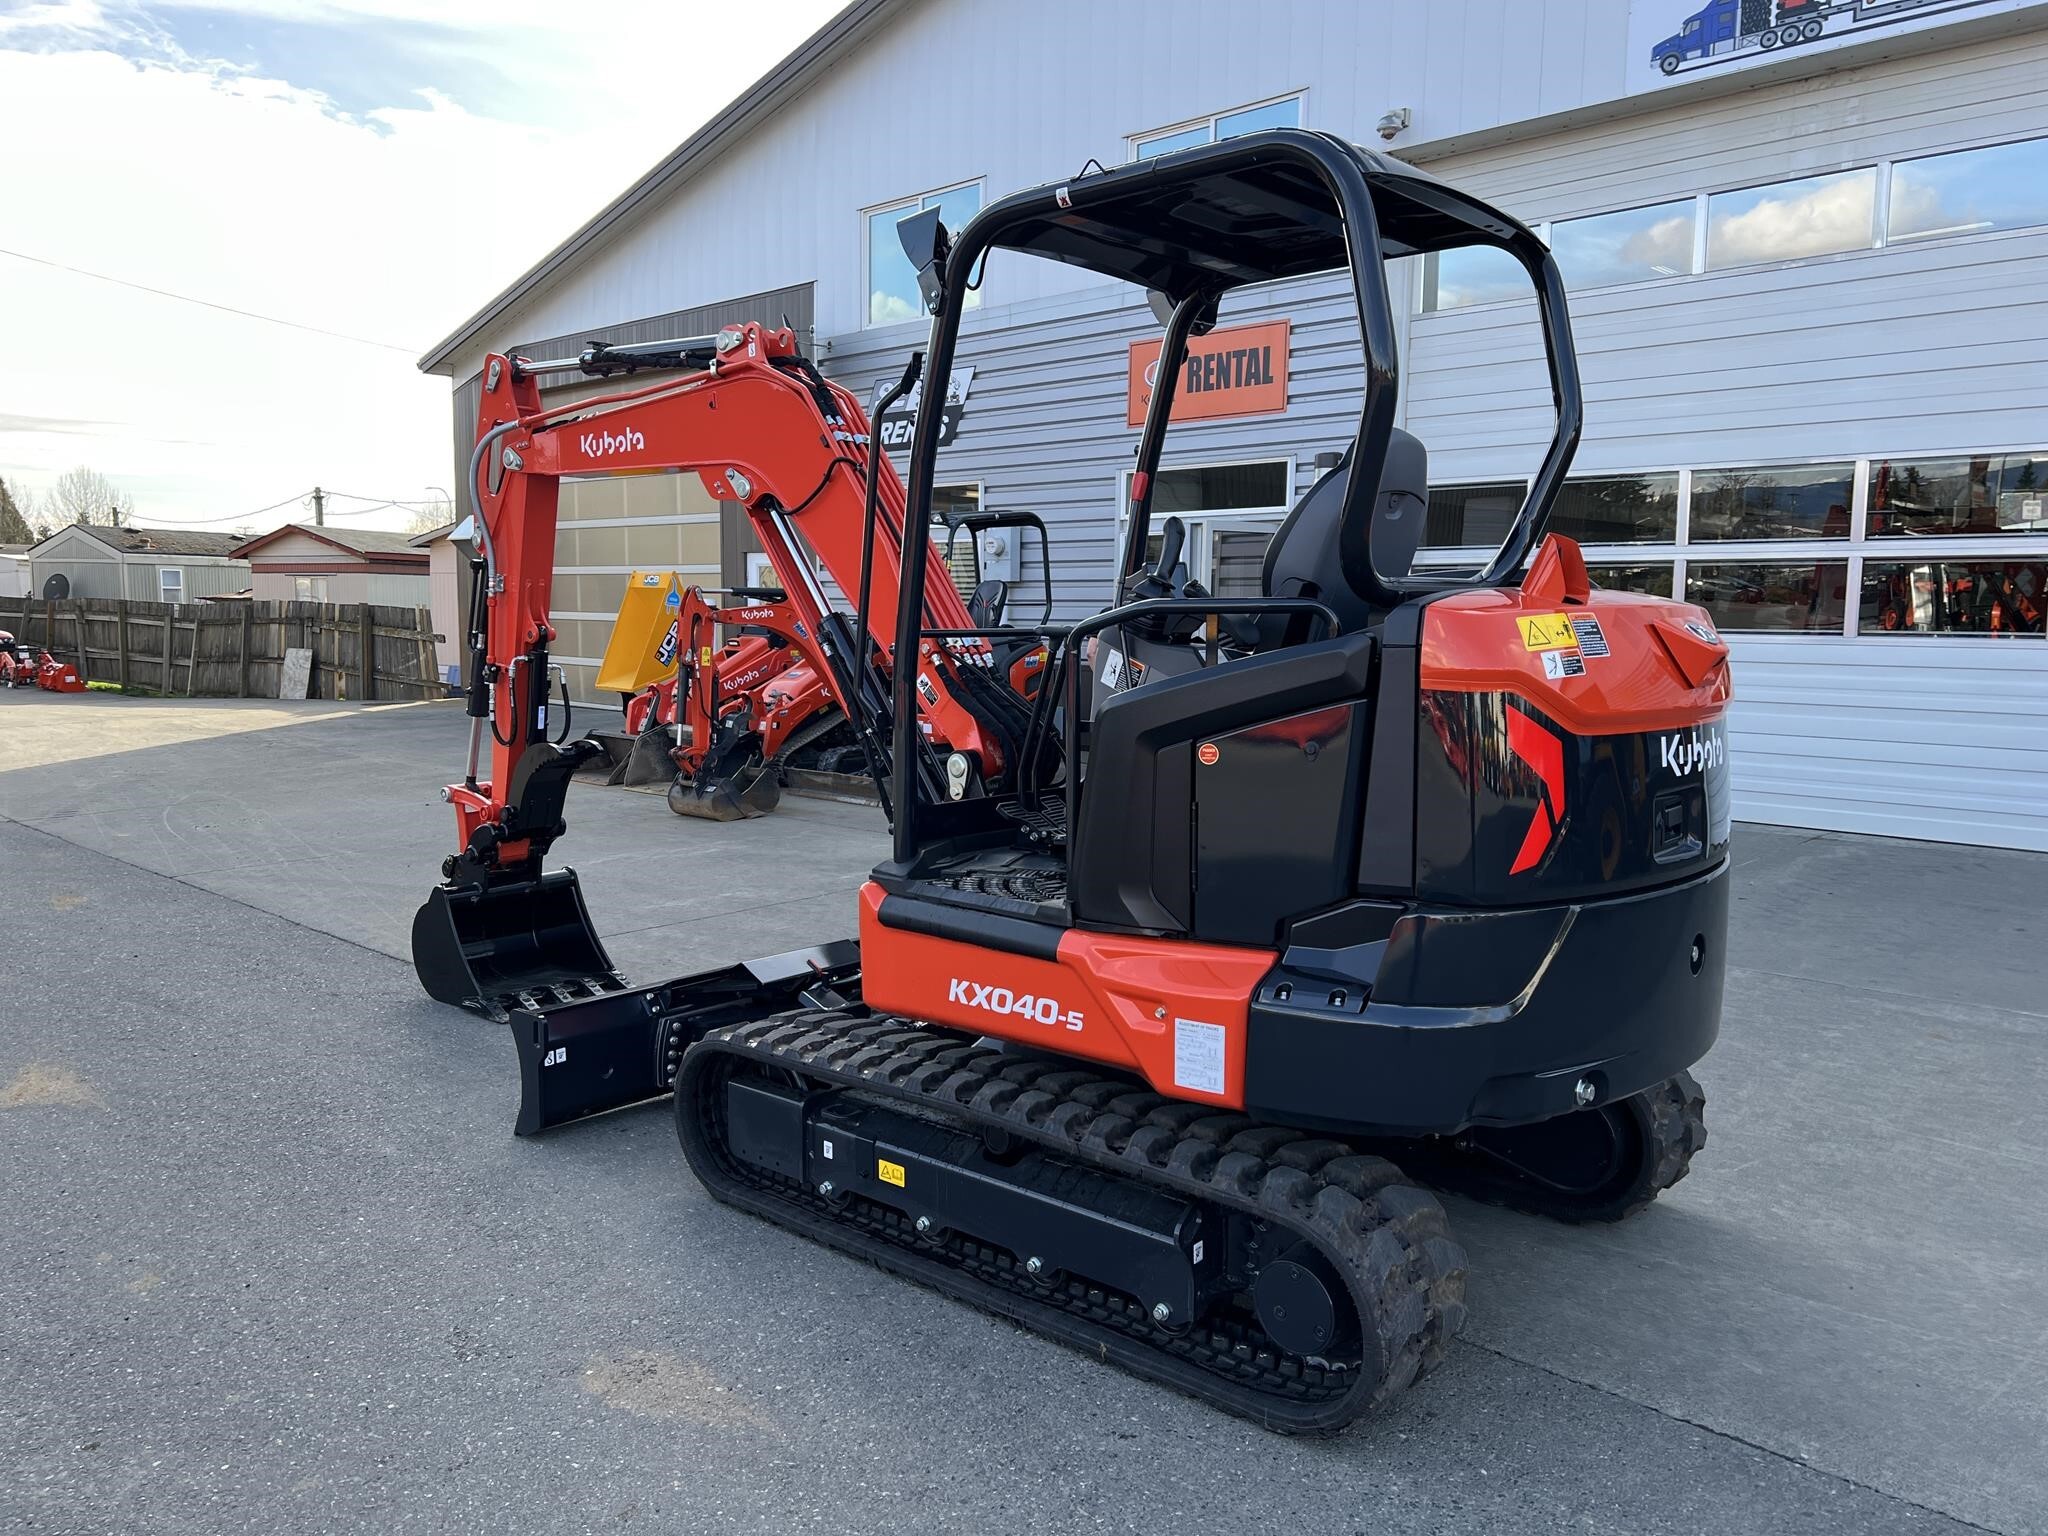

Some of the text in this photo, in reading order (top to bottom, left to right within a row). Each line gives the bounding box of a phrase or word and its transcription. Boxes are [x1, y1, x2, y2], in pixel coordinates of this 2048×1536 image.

[1187, 346, 1273, 393] RENTAL
[580, 426, 645, 458] Kubota
[644, 575, 660, 583] JCB
[741, 609, 774, 620] Kubota
[723, 669, 760, 691] Kubota
[1661, 727, 1723, 777] Kubota
[948, 978, 1084, 1032] KX040-5
